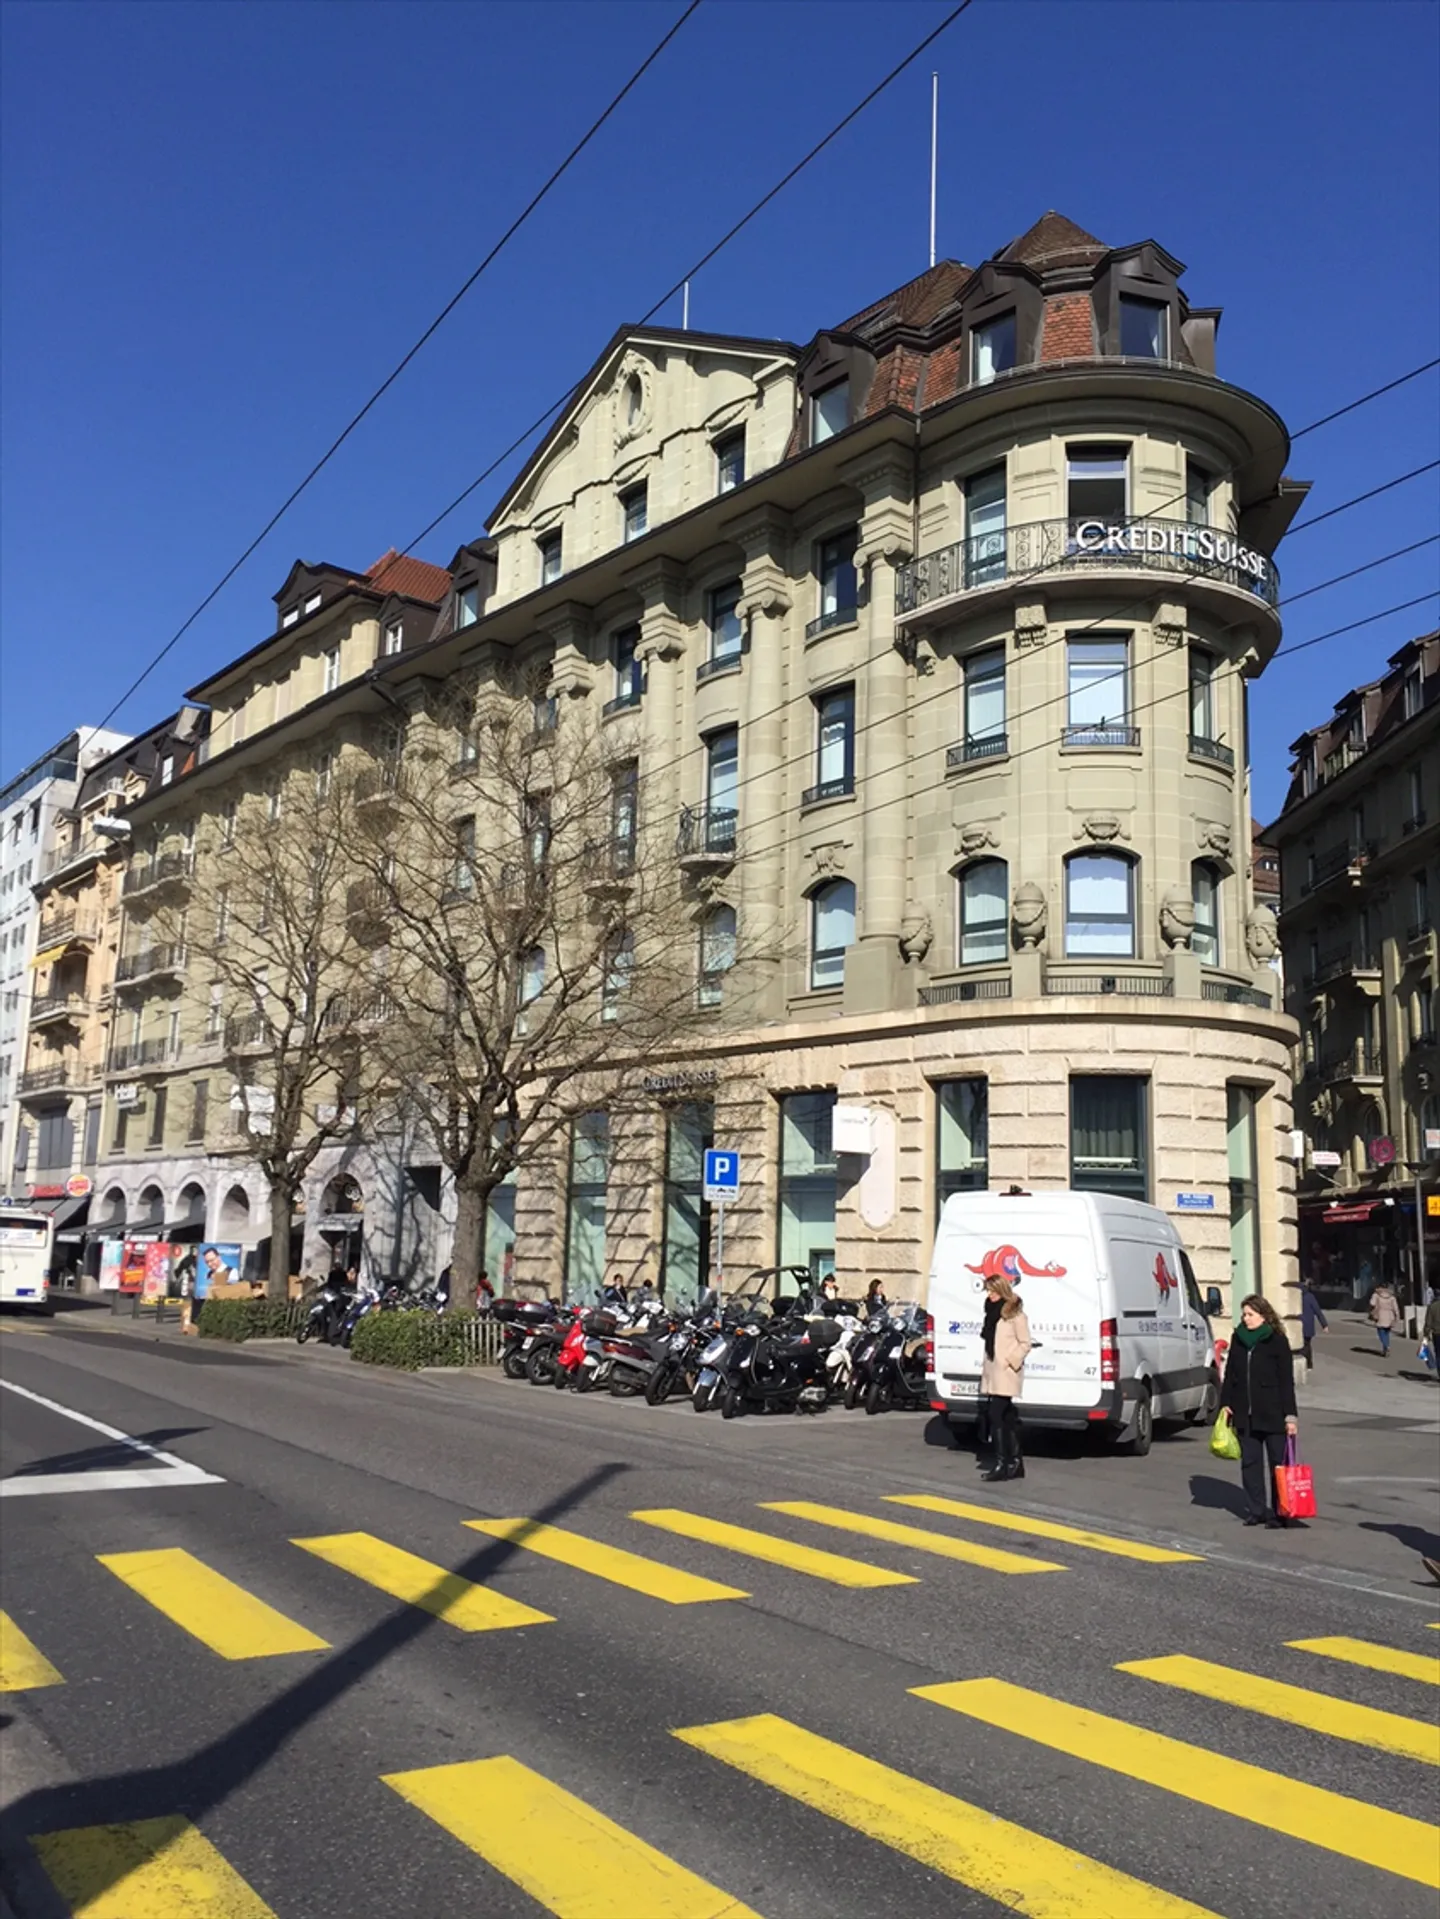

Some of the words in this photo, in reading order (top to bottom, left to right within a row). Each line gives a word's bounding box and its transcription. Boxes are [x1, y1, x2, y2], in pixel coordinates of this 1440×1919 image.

[1076, 521, 1195, 554] CREDIT
[1199, 530, 1268, 581] SUISSE
[714, 1156, 730, 1182] P
[1084, 1366, 1097, 1376] 47
